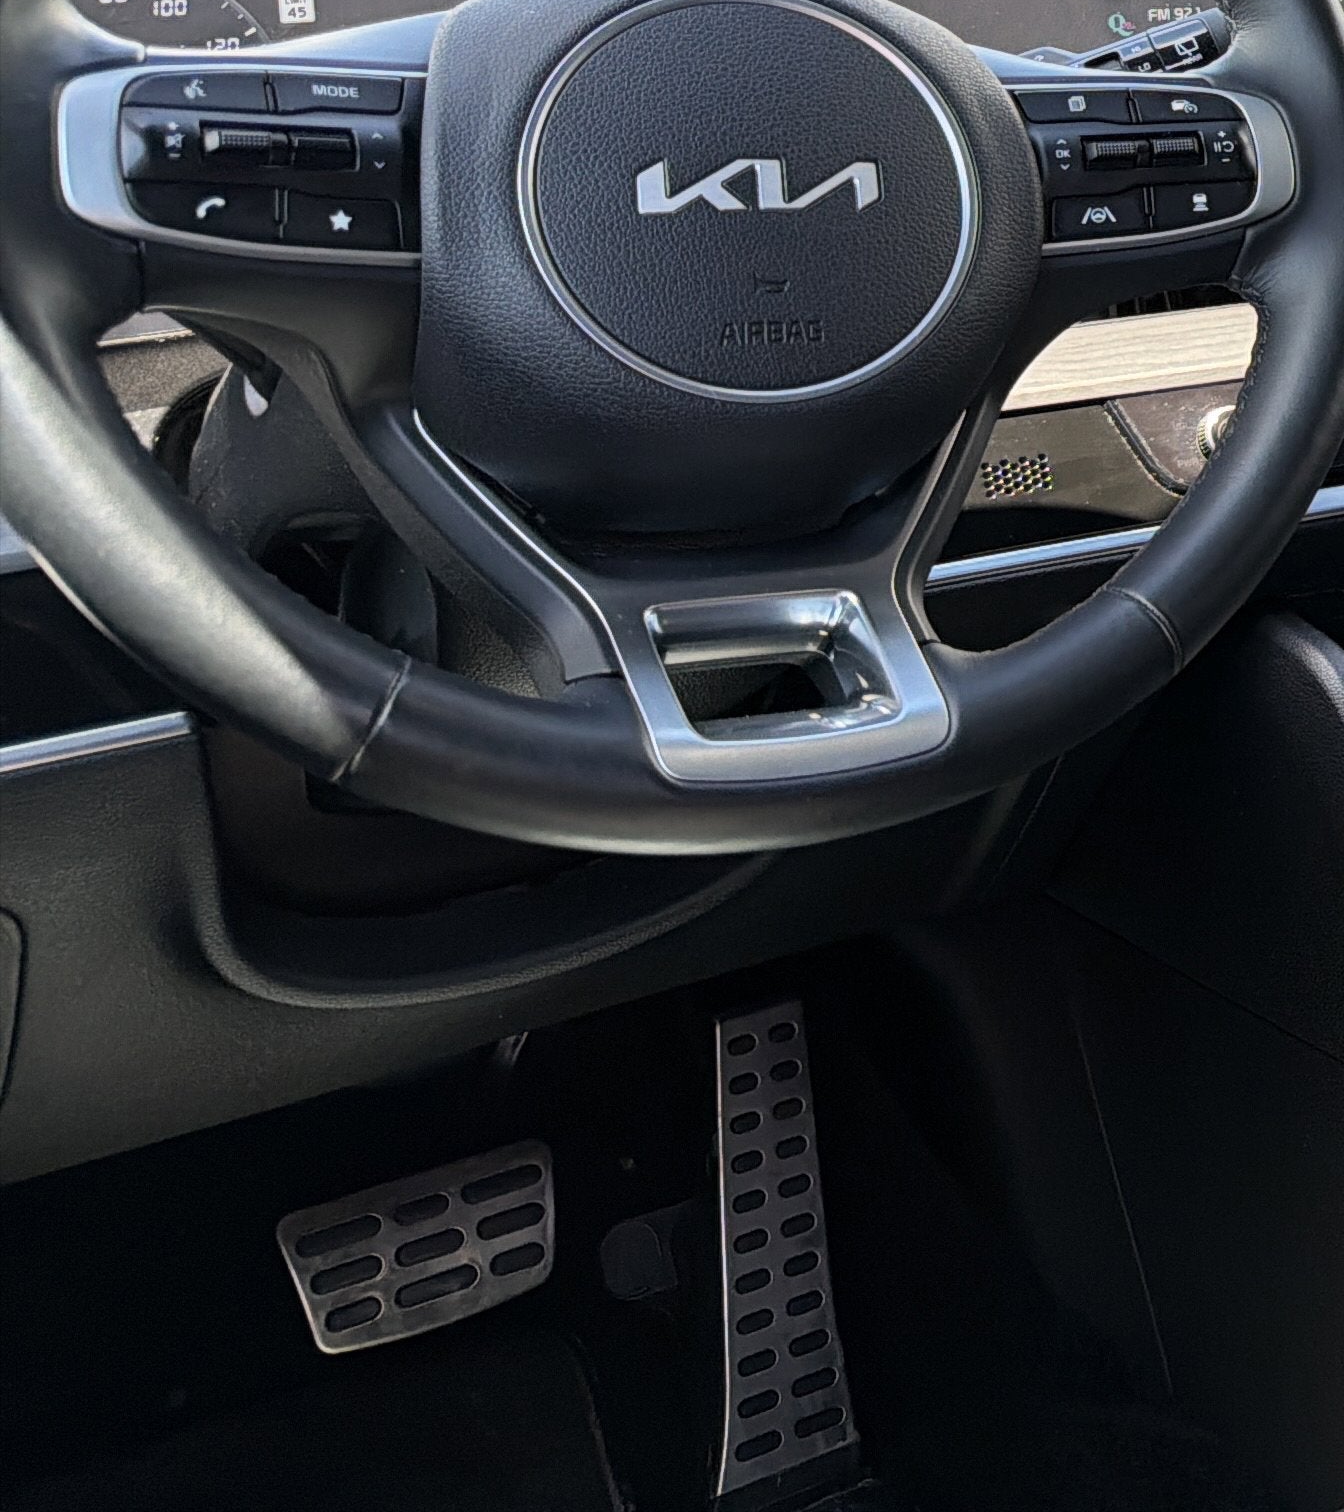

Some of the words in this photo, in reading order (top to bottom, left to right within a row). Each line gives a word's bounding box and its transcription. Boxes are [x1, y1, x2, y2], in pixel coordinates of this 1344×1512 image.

[287, 6, 307, 19] 45
[1148, 8, 1171, 22] FM
[312, 84, 360, 99] MODE
[1055, 148, 1071, 159] OK
[636, 157, 884, 215] KIA
[721, 319, 825, 347] AIRBAG
